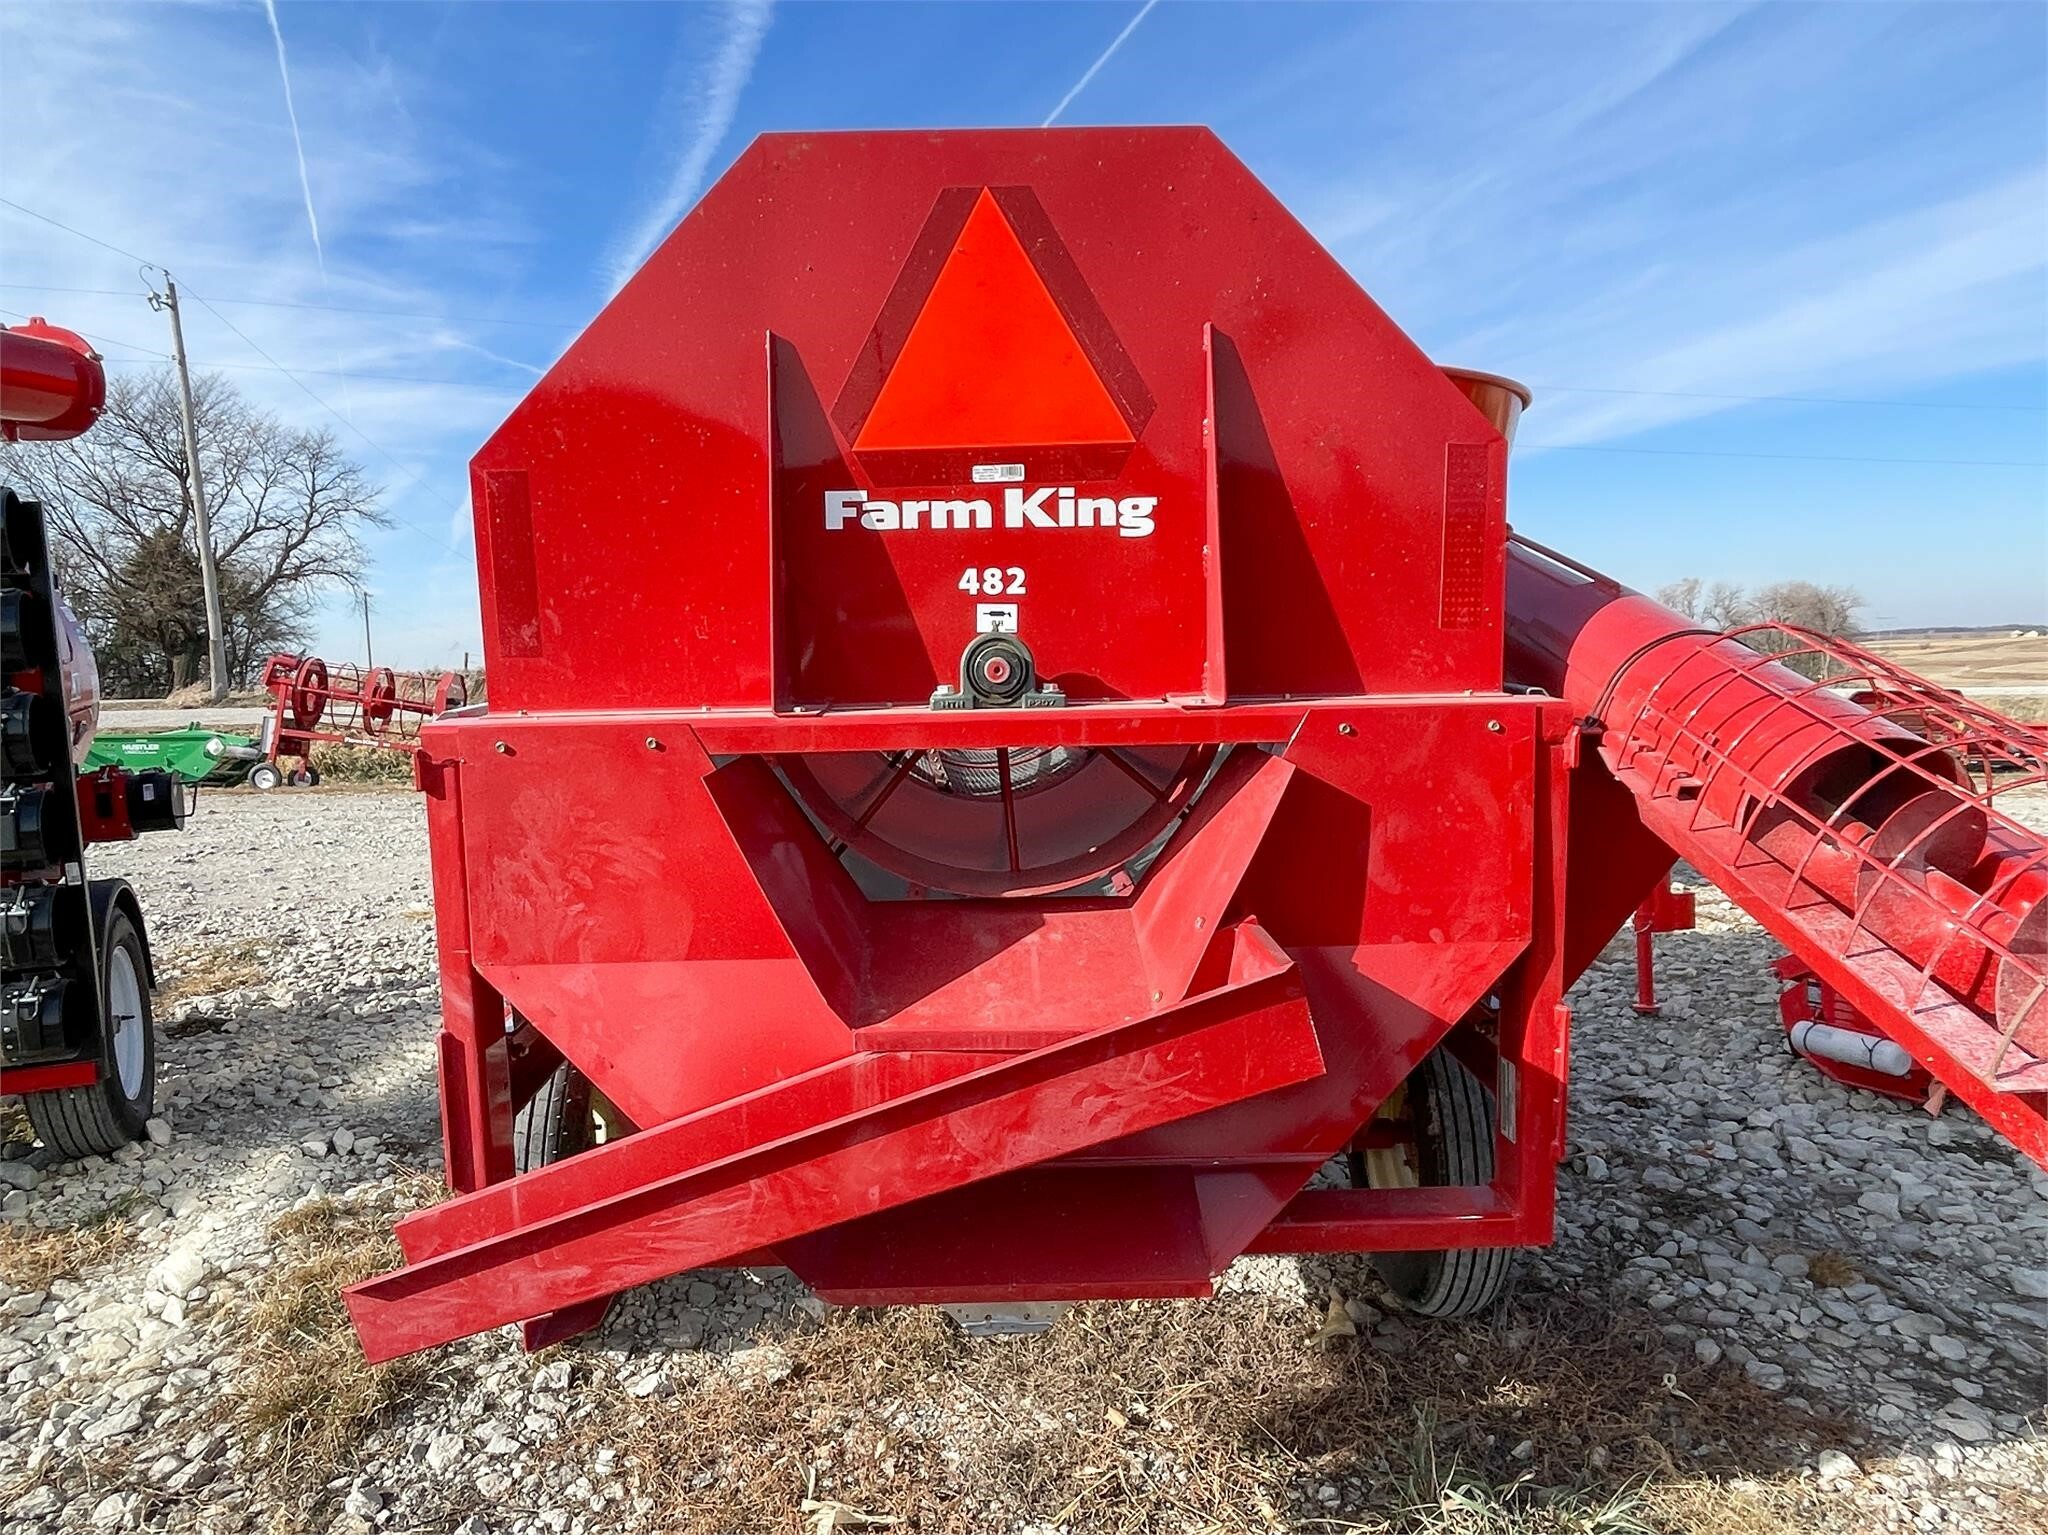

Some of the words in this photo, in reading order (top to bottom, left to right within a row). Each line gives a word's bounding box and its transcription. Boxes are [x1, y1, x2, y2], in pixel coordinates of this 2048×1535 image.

[824, 490, 993, 530] Farm
[1004, 487, 1157, 536] King
[958, 567, 1026, 595] 482
[121, 743, 160, 751] HUSTLER
